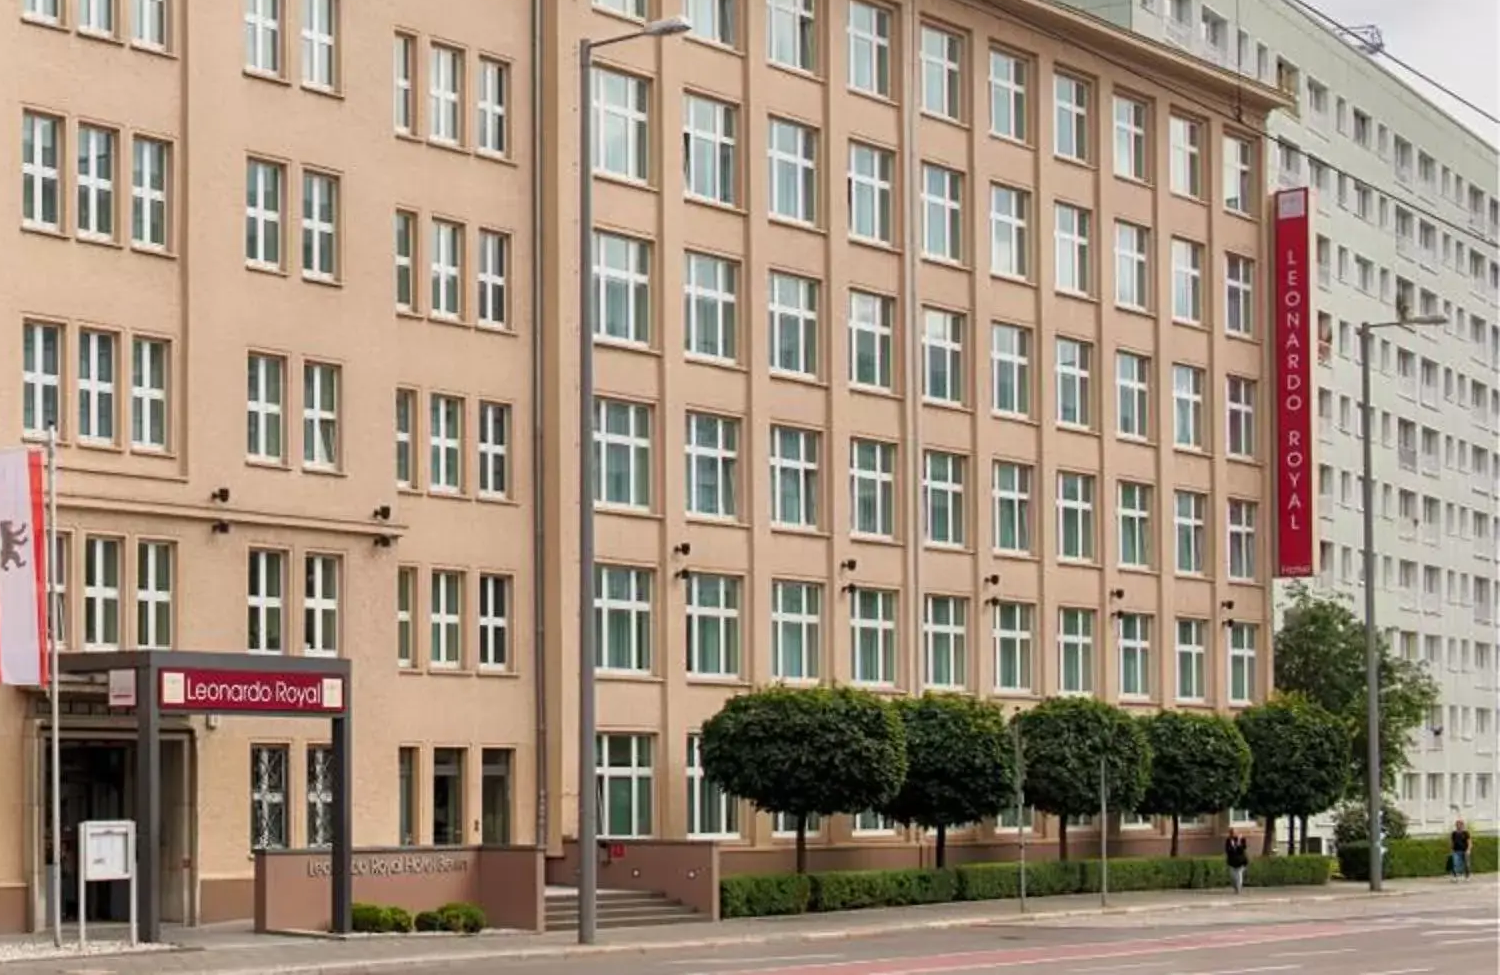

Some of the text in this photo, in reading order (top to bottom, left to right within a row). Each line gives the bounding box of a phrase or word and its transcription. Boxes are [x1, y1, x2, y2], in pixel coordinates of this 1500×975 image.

[1285, 249, 1303, 530] LEONARDO ROYAL
[187, 678, 321, 707] Leonardo Royal
